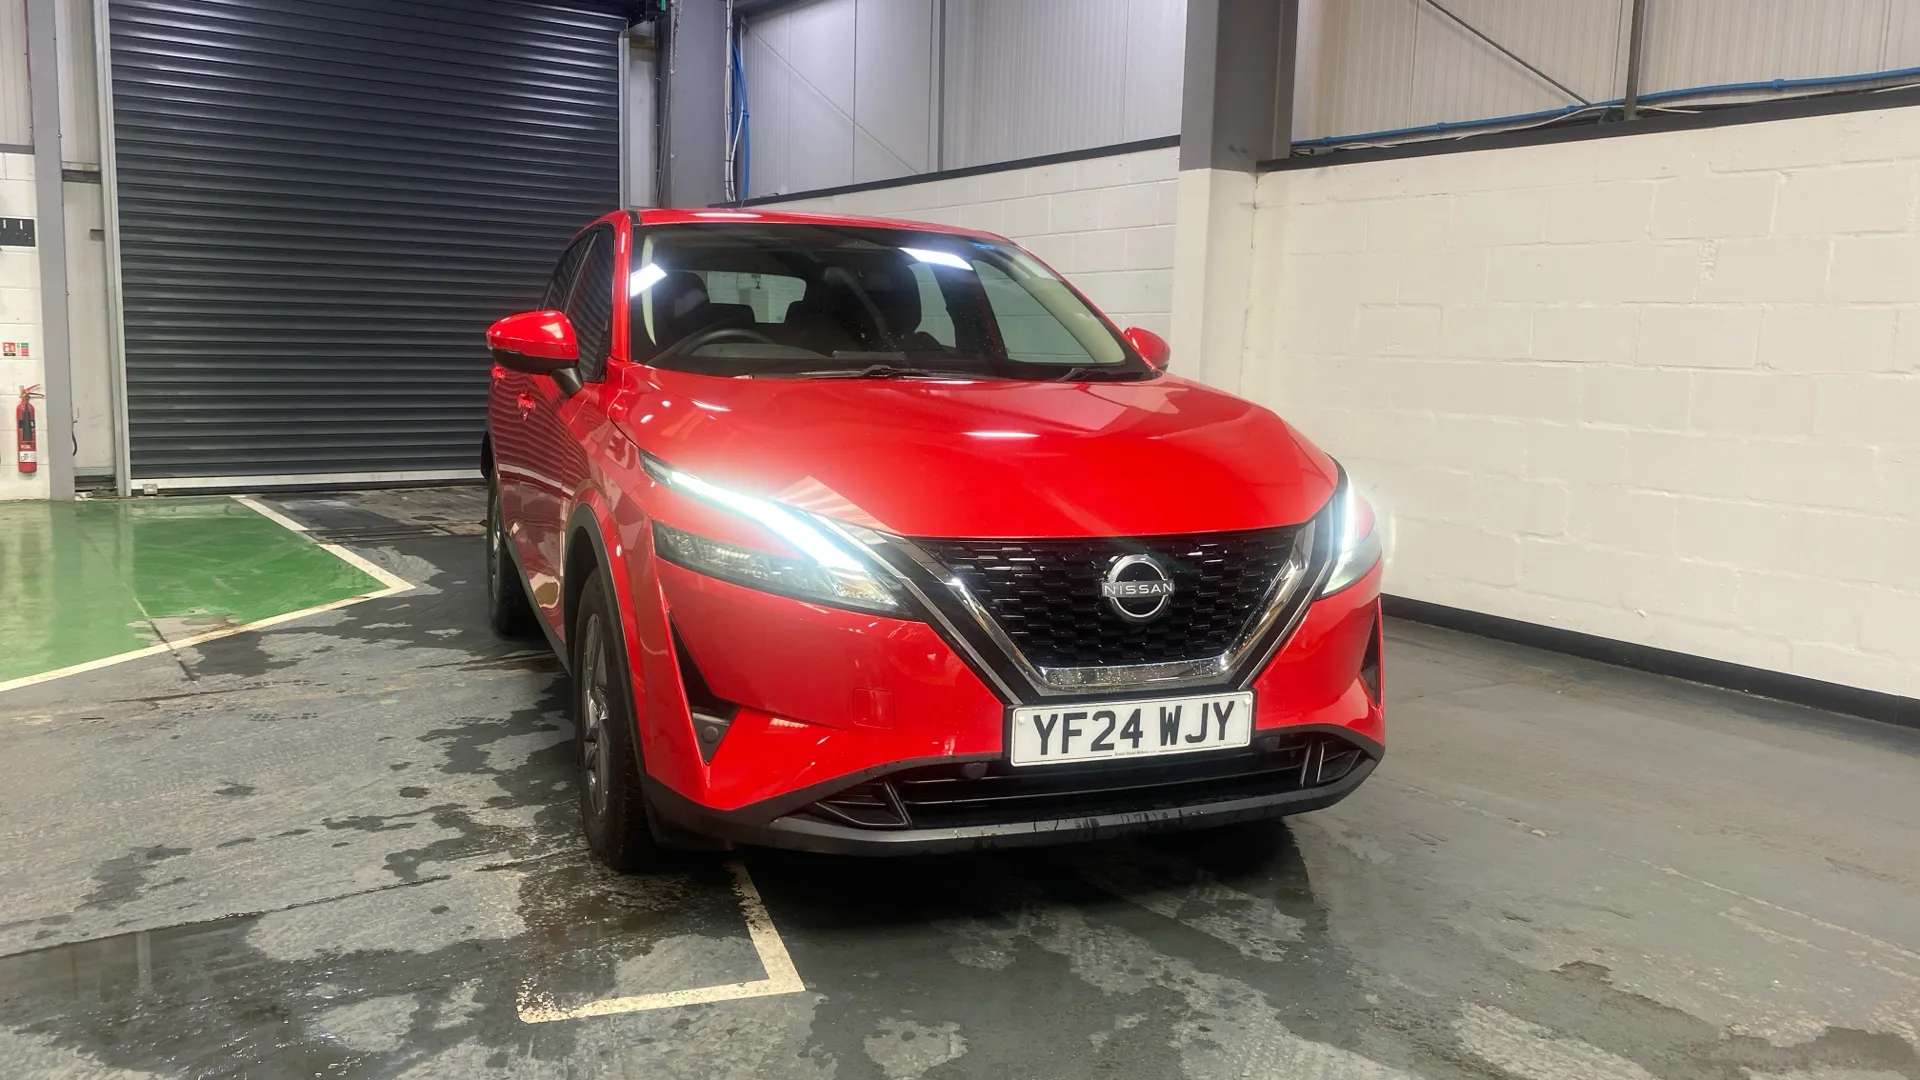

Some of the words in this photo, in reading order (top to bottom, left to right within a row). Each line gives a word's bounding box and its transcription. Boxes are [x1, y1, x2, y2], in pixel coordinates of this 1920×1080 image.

[1104, 582, 1173, 595] NISSAN
[1032, 708, 1144, 756] YF24
[1159, 700, 1235, 747] WJY
